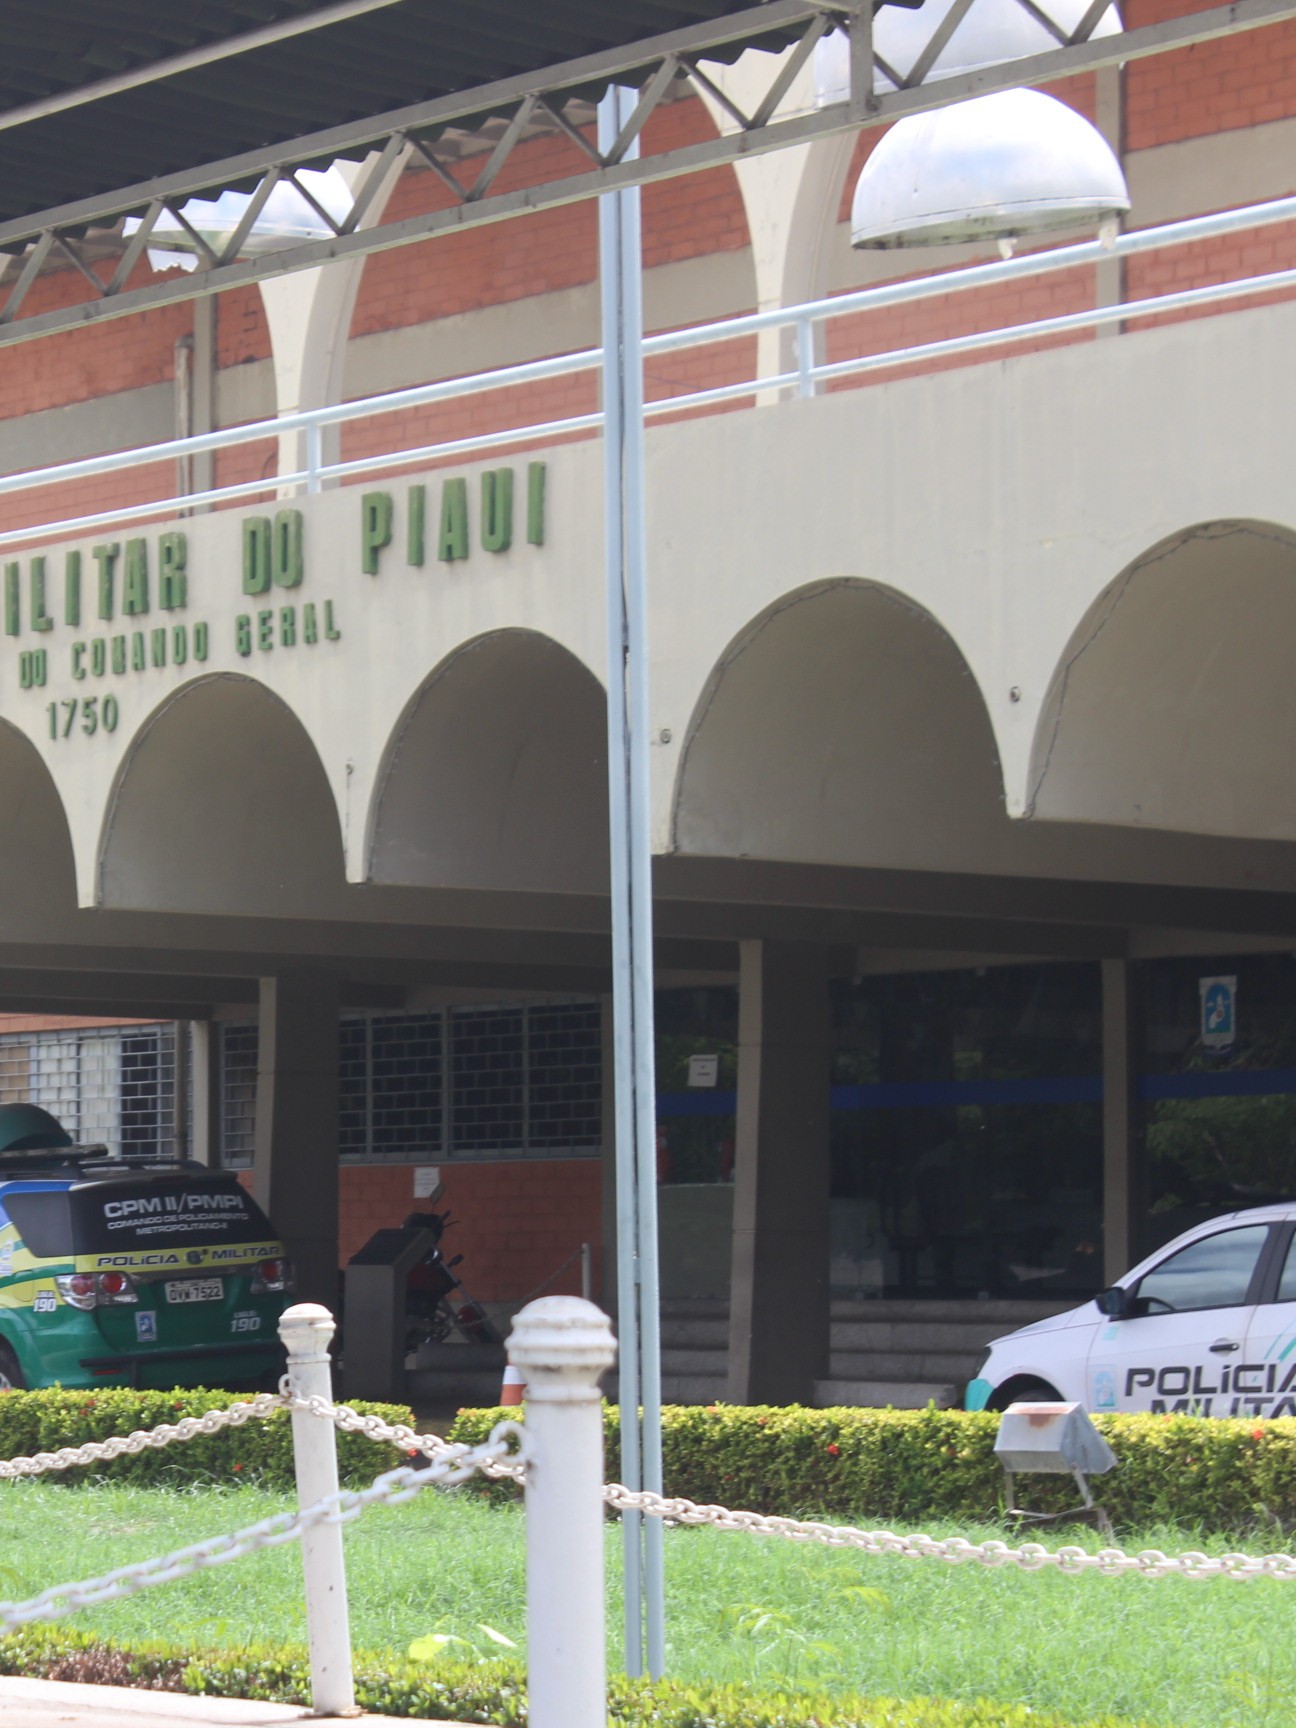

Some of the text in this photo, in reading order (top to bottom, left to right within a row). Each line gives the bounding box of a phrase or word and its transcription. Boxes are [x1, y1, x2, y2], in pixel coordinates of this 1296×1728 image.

[242, 509, 303, 595] DO
[361, 461, 546, 575] PIAUI
[19, 648, 47, 689] DO
[72, 621, 208, 680] COMANDO
[236, 599, 341, 657] GERAL
[46, 693, 119, 740] 1750
[104, 1197, 162, 1218] CPM
[107, 1213, 249, 1230] COMANDO DE POLICIAMENTO
[211, 1246, 281, 1260] MILITAR
[33, 1298, 57, 1312] 190
[230, 1317, 261, 1332] 190
